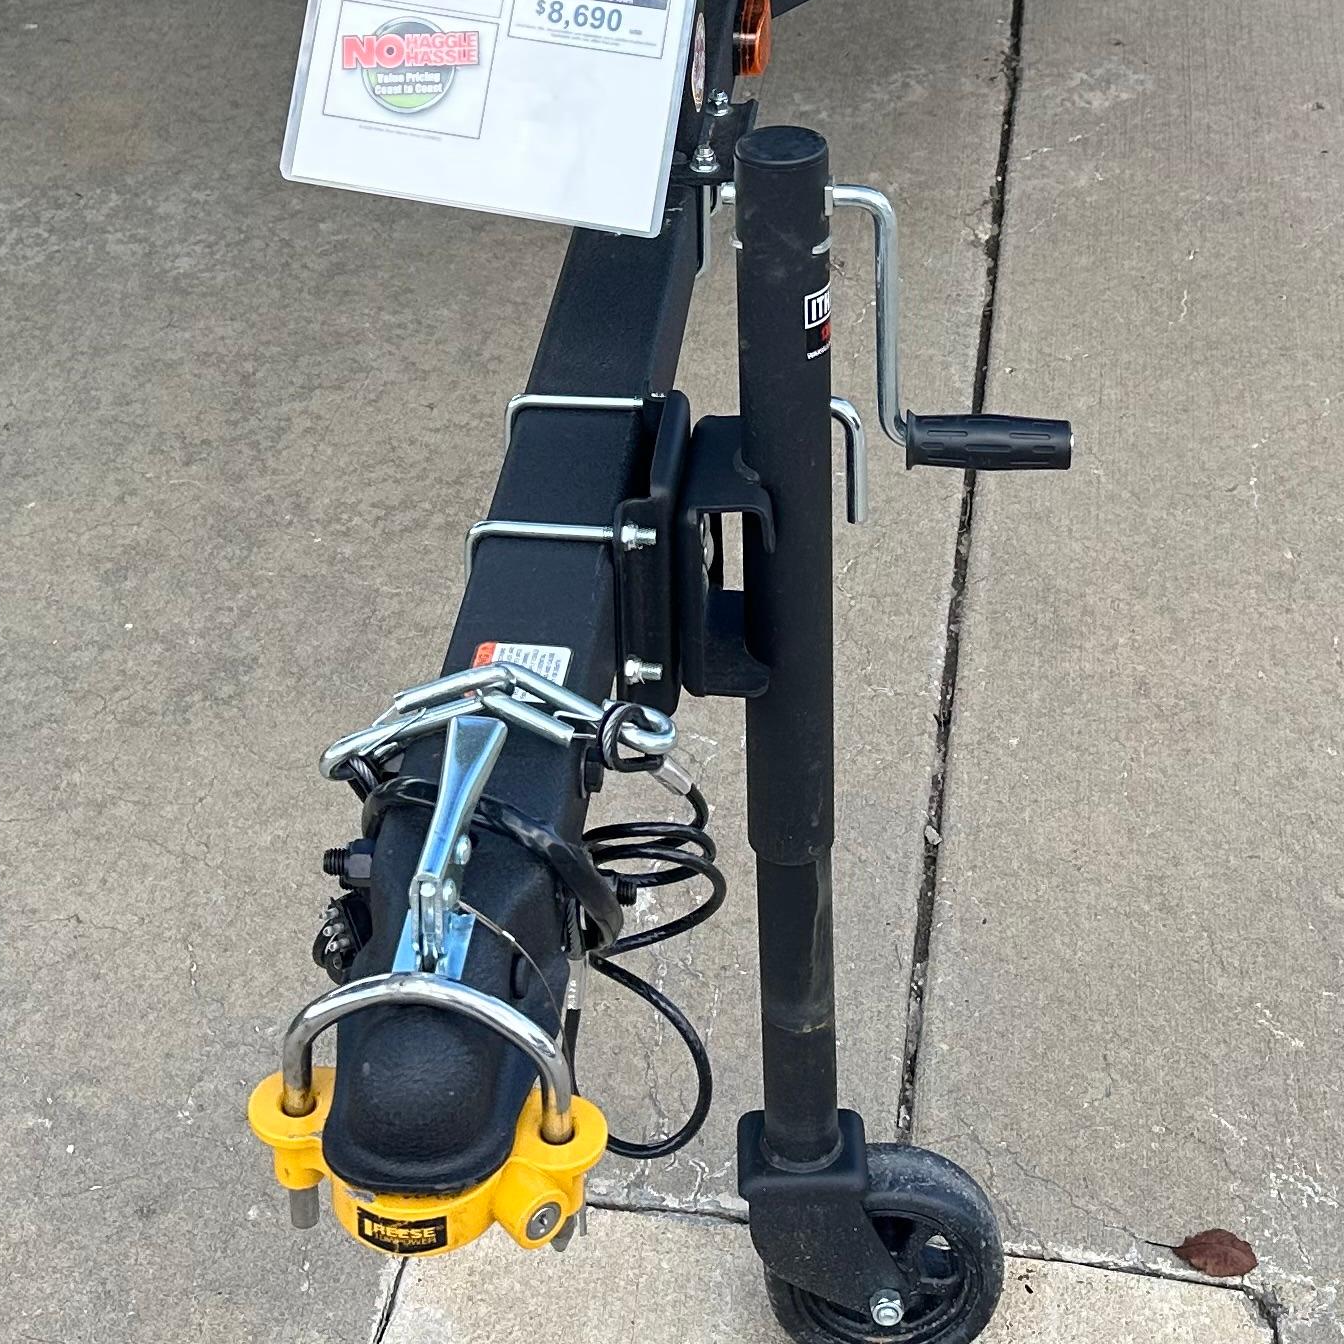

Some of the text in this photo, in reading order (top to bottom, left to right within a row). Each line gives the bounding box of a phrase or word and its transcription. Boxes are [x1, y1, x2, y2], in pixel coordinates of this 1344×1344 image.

[535, 0, 623, 32] $8,690
[405, 31, 478, 50] HAGGLE
[343, 34, 406, 70] NO
[405, 48, 478, 66] HASSLE
[373, 1222, 436, 1239] REESE
